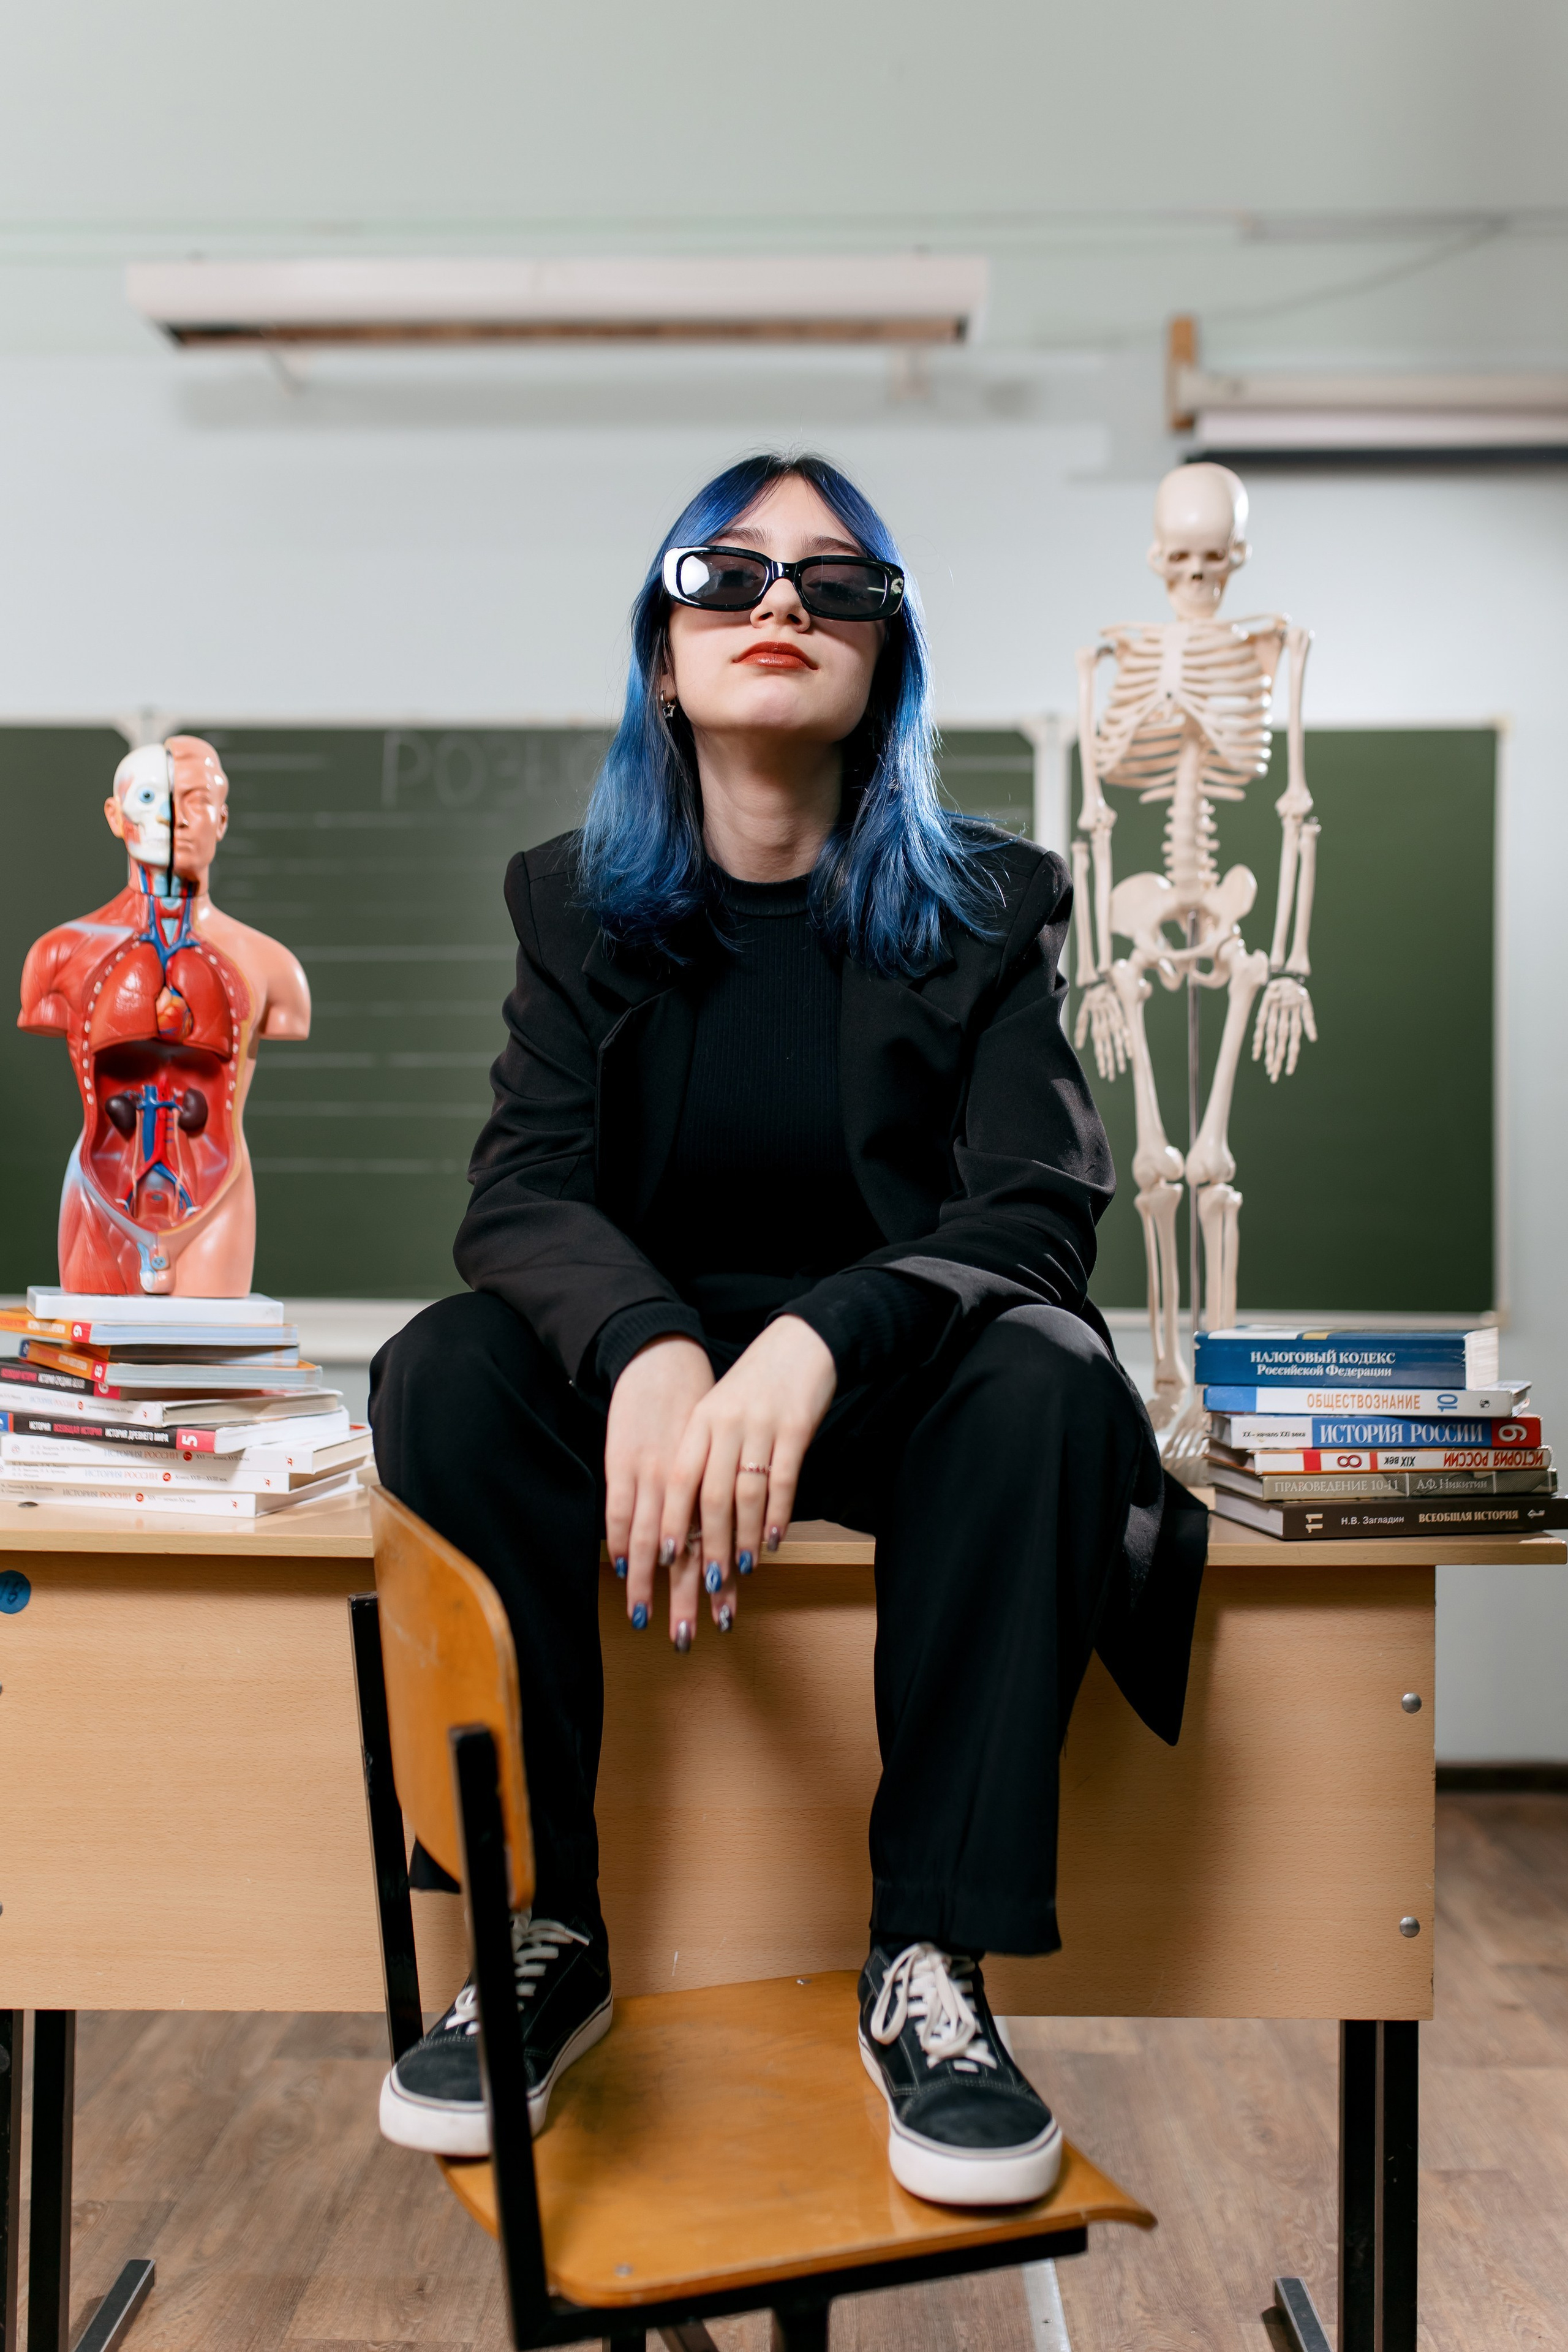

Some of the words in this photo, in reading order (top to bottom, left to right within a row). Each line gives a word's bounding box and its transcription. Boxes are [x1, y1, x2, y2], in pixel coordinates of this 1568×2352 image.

[73, 1324, 83, 1338] 9
[1250, 1349, 1337, 1363] НАЛОГОВЫЙ
[1339, 1351, 1396, 1365] КОДЕКС
[94, 1365, 103, 1378] 8
[1257, 1363, 1324, 1376] Российской
[1325, 1365, 1392, 1379] Федерации
[1307, 1393, 1420, 1411] ОБЩЕСТВОЗНАНИЕ
[1437, 1393, 1458, 1412] 10
[29, 1420, 51, 1431] ИСТОРИЯ
[80, 1426, 102, 1436] ИСТОРИЯ
[105, 1428, 128, 1439] ИСТОРИЯ
[128, 1430, 154, 1441] ДРЕВНЕГО
[154, 1432, 169, 1442] МИРА
[1319, 1423, 1404, 1444] ИСТОРИЯ
[1410, 1423, 1484, 1442] РОССИИ
[1498, 1423, 1528, 1442] 9
[181, 1434, 198, 1447] 5
[144, 1450, 179, 1460] РОССИИ
[1337, 1455, 1362, 1468] 8
[1384, 1456, 1399, 1465] век
[1400, 1456, 1416, 1467] XIX
[1444, 1451, 1489, 1468] РОССИИ
[1493, 1450, 1544, 1467] ИСТОРИЯ
[1275, 1480, 1368, 1493] ПРАВОВЕДЕНИЕ
[1371, 1479, 1399, 1491] 10-11
[1417, 1479, 1438, 1489] А.Ф.
[1439, 1479, 1488, 1489] Никитин
[1305, 1513, 1323, 1534] 11
[1341, 1517, 1360, 1525] Н.В.
[1362, 1515, 1404, 1525] Загладин
[1418, 1511, 1472, 1523] ВСЕОБЩАЯ
[1474, 1510, 1519, 1521] ИСТОРИЯ
